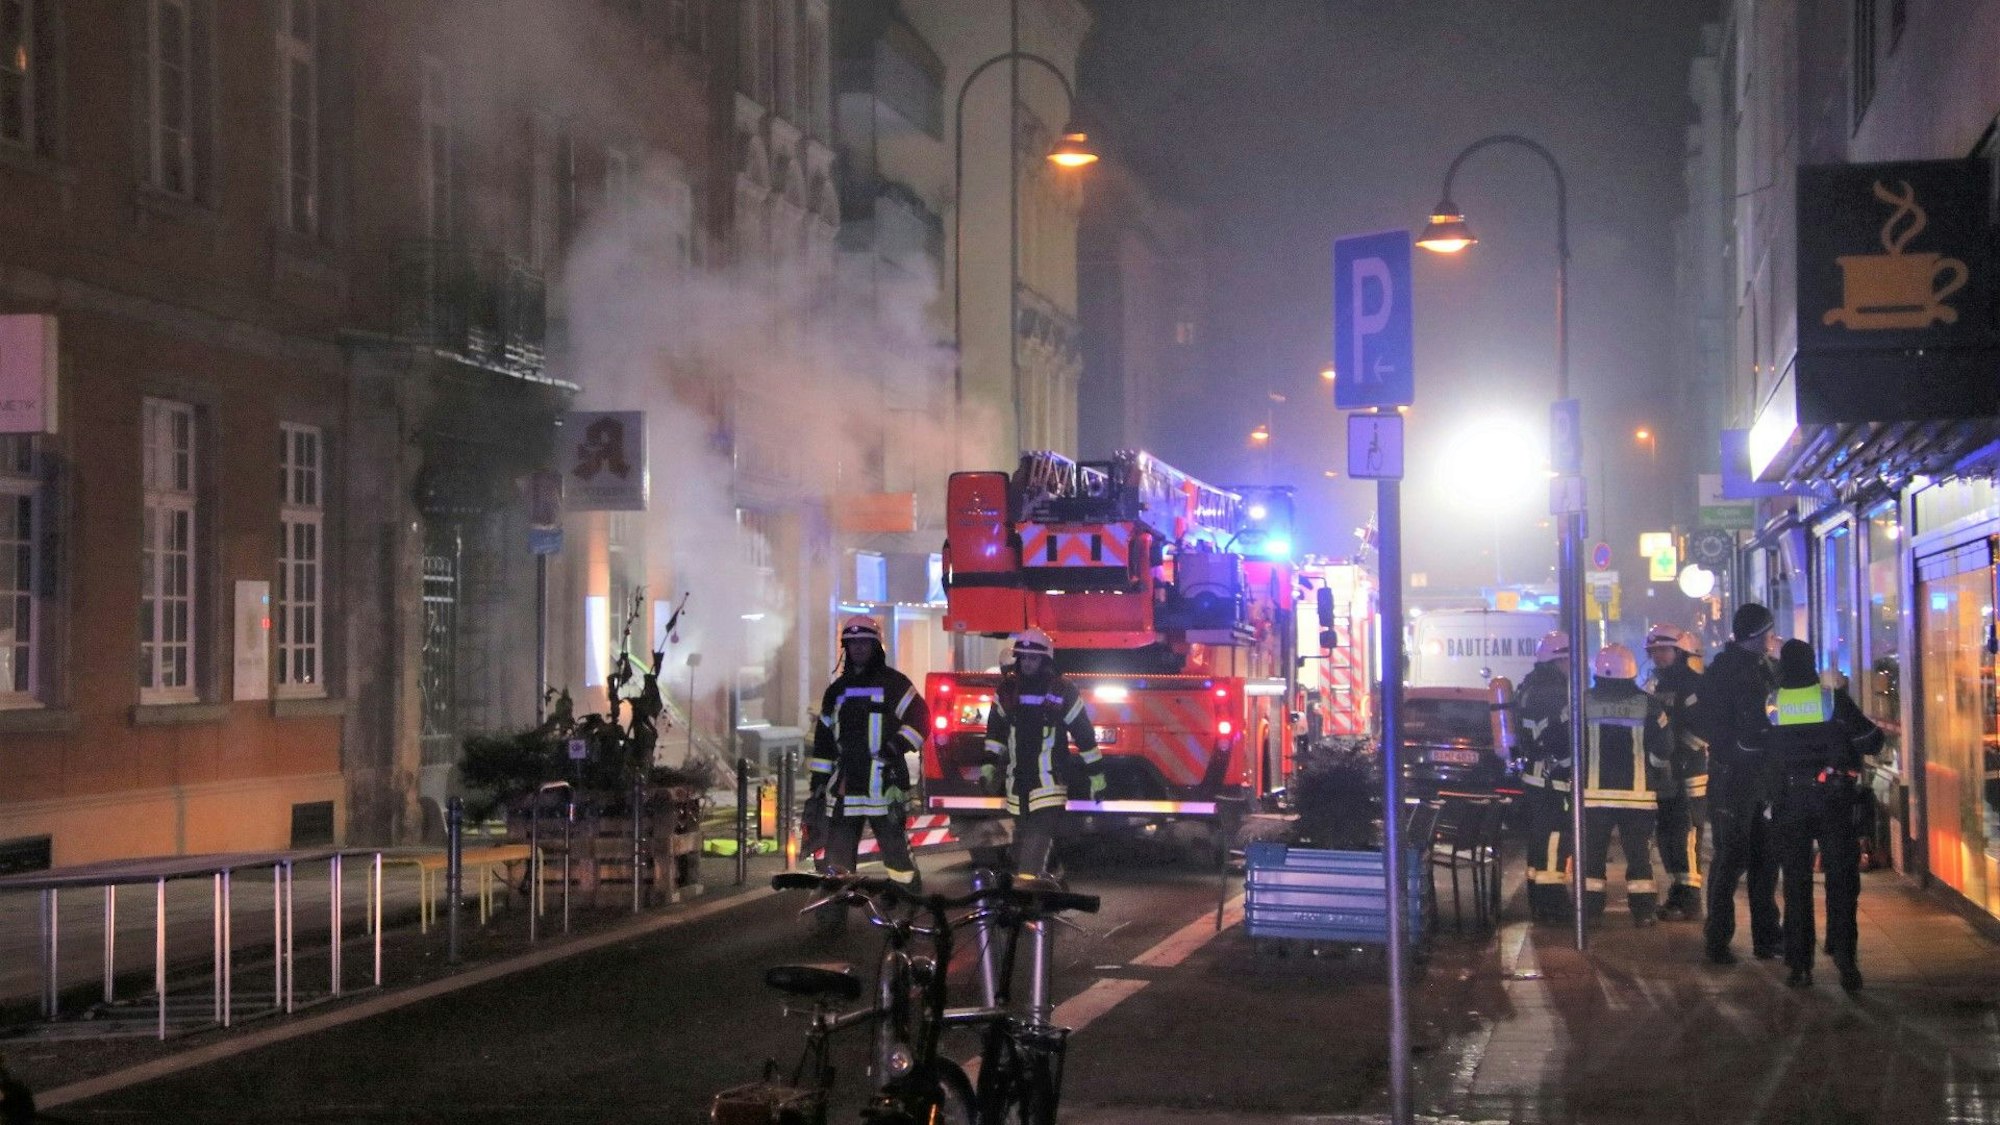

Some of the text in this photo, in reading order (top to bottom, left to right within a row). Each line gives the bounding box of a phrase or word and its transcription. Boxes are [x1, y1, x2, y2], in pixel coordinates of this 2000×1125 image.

[1353, 257, 1393, 384] P
[1447, 638, 1512, 656] BAUTEAM
[1780, 702, 1819, 715] POLIZEI
